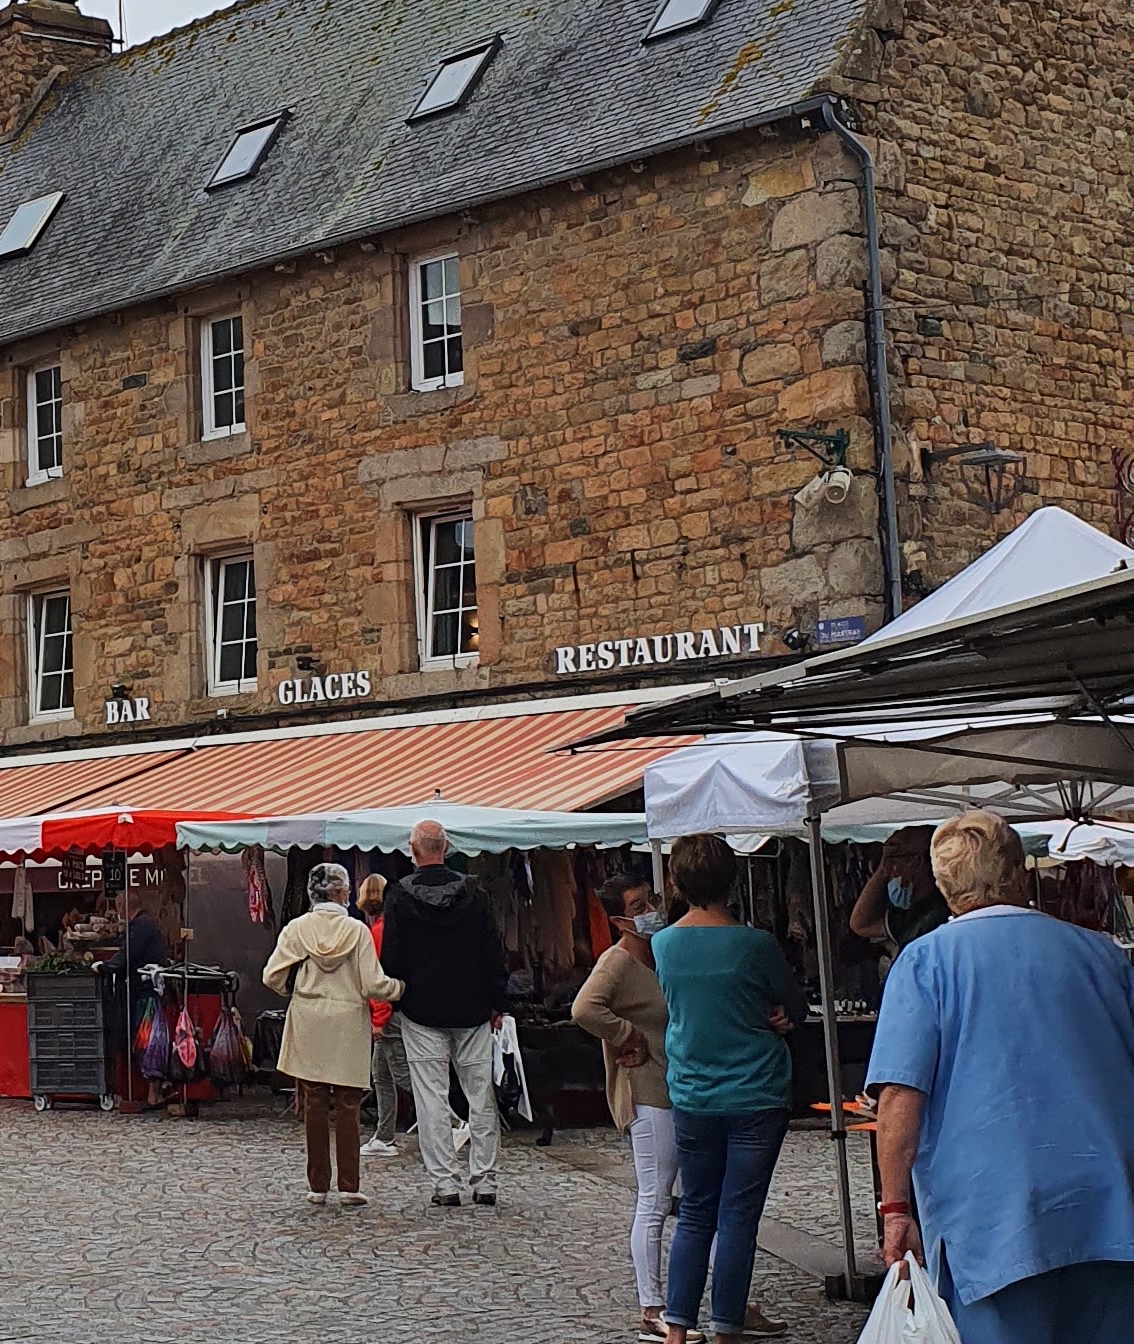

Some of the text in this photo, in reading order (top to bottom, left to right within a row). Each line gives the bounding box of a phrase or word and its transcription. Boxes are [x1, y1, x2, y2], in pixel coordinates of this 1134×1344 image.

[556, 623, 764, 674] RESTAURANT
[278, 671, 371, 705] GLACES
[106, 697, 150, 724] BAR
